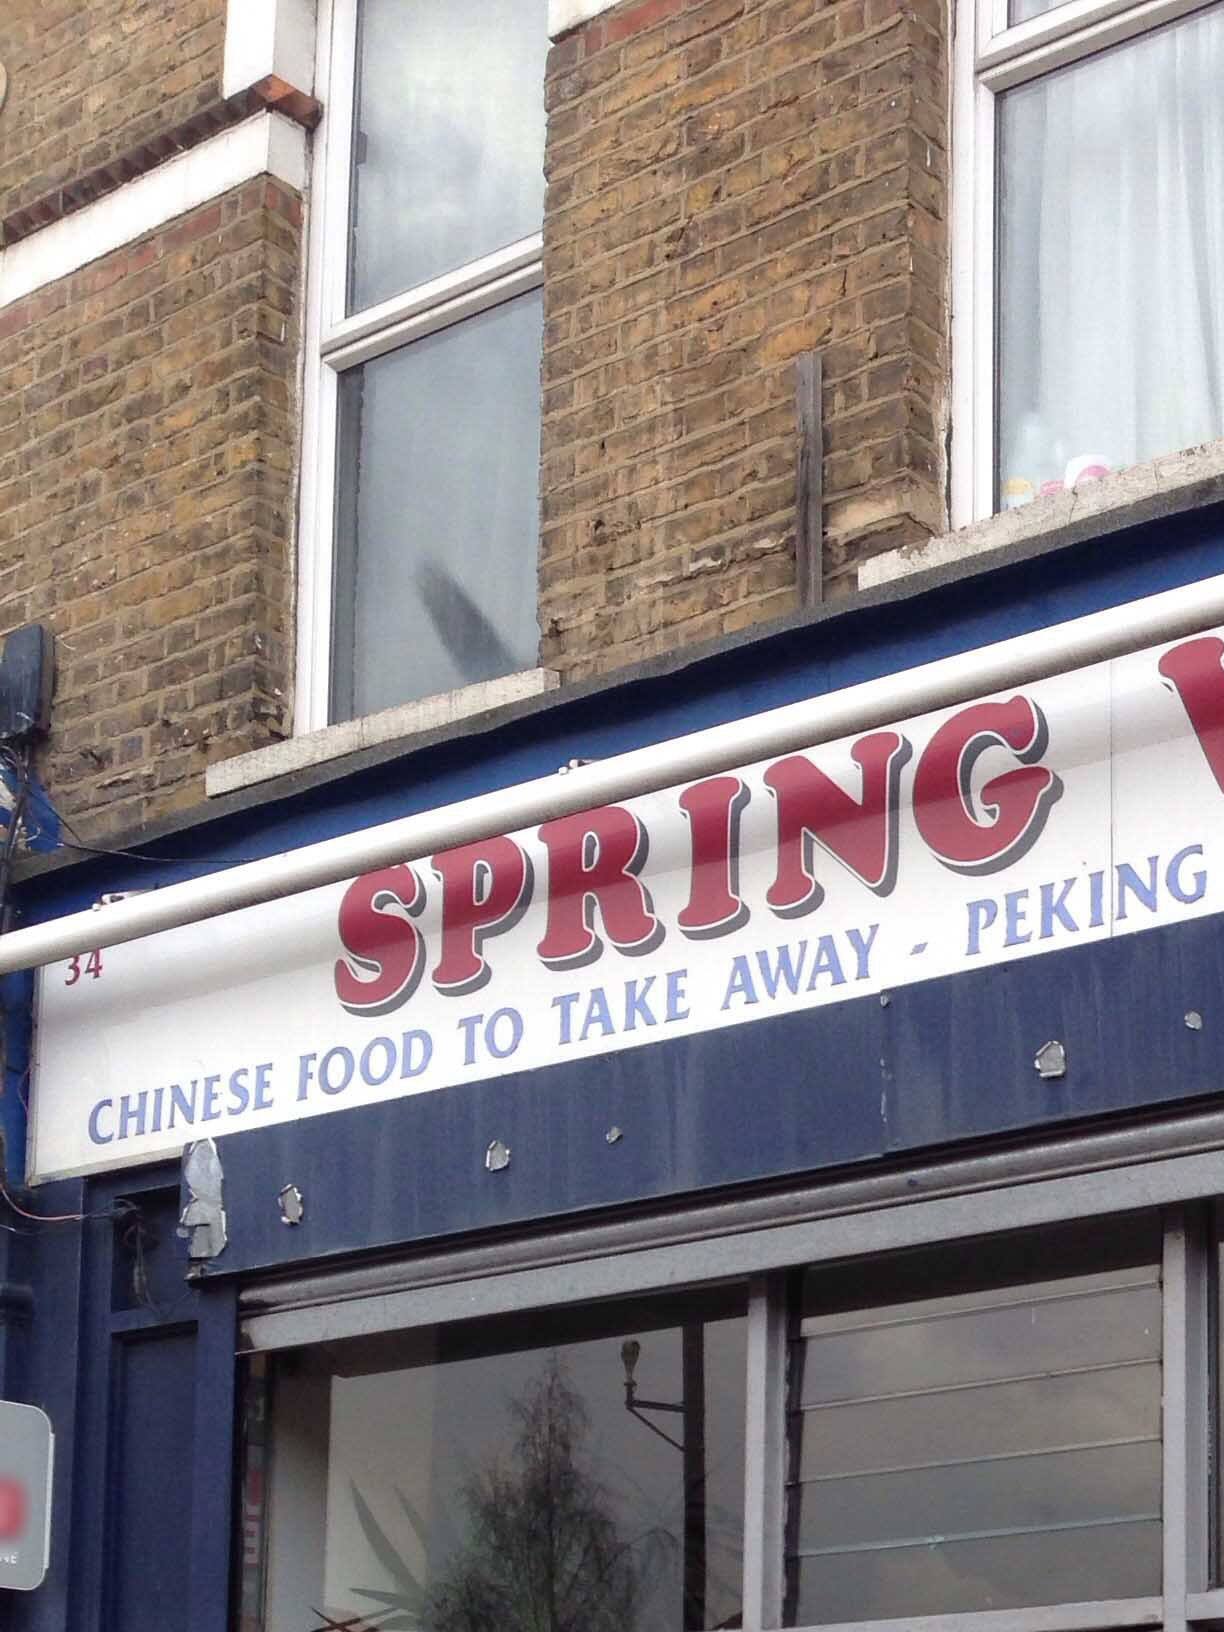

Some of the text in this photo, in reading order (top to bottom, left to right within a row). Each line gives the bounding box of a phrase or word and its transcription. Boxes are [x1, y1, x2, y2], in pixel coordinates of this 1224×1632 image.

[65, 947, 103, 986] 34
[88, 1062, 275, 1146] CHINESE
[297, 1028, 433, 1101] FOOD
[457, 1006, 524, 1067] TO
[550, 967, 690, 1046] TAKE
[721, 923, 881, 1011] AWAY
[965, 843, 1206, 957] PEKING
[334, 695, 1063, 1015] SPRING
